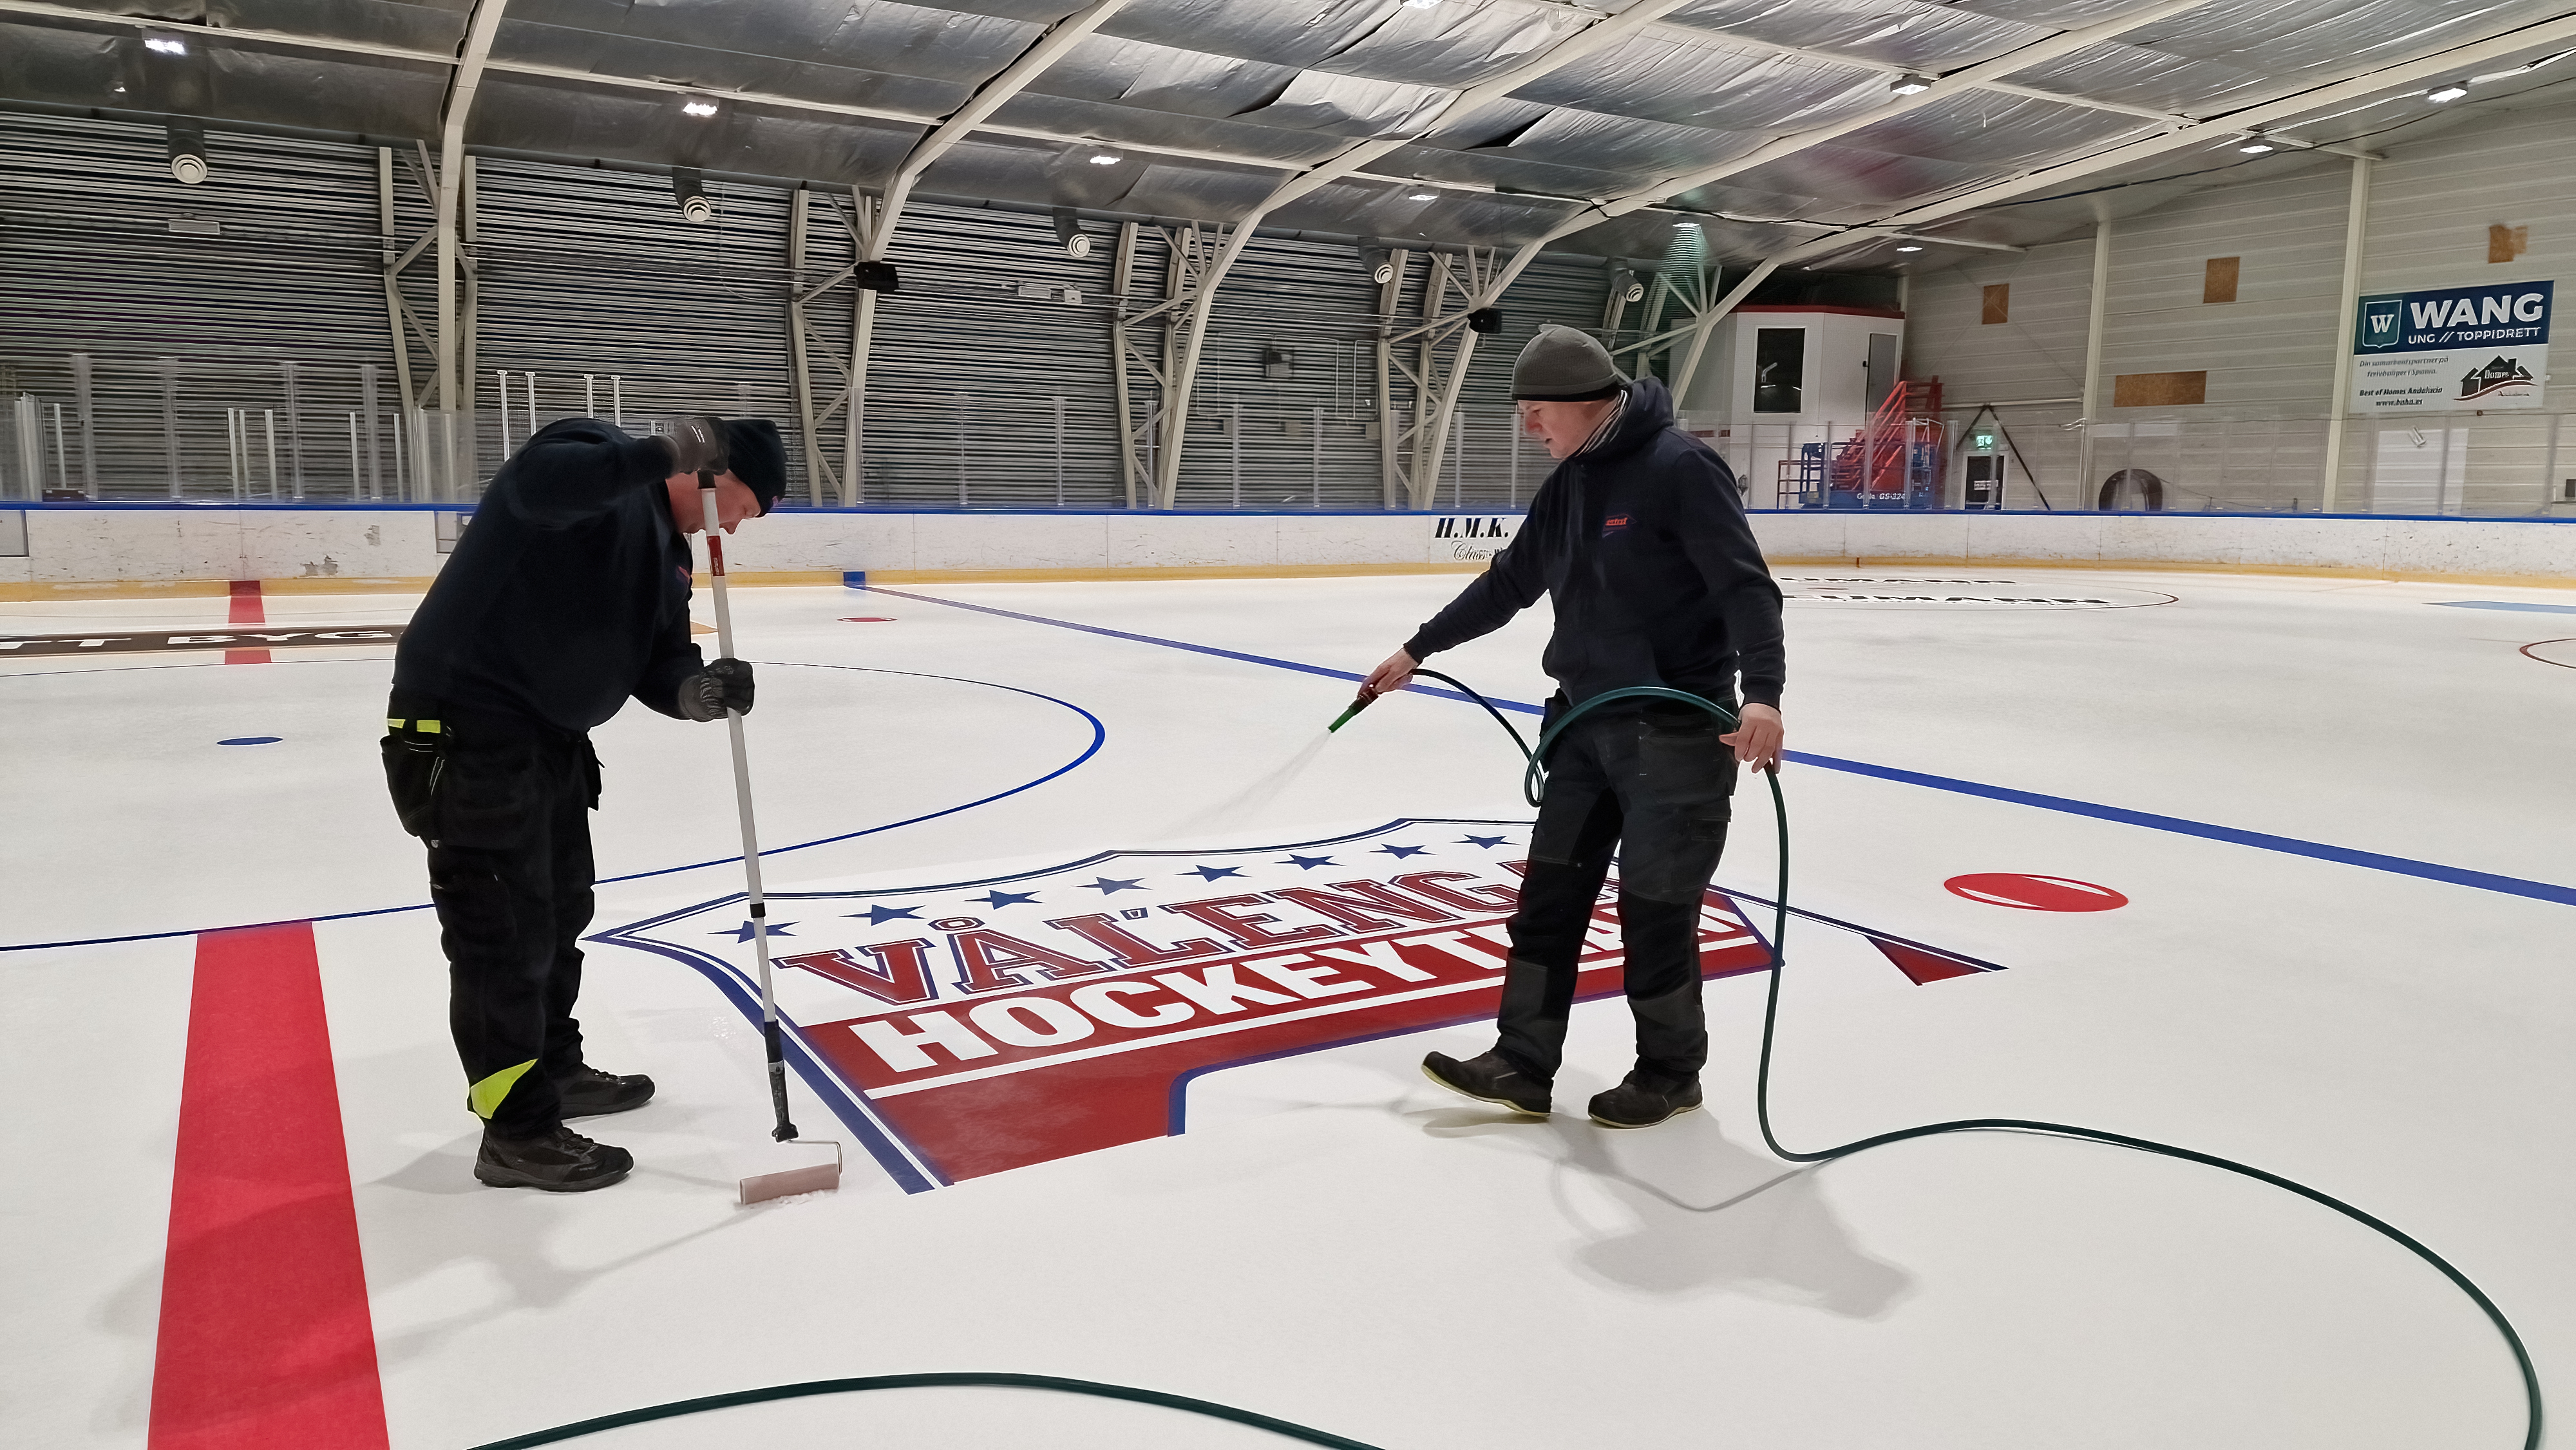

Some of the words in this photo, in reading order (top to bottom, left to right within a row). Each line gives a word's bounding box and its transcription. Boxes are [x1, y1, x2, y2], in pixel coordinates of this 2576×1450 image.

[2410, 293, 2544, 329] WANG
[2370, 314, 2394, 334] W
[2408, 334, 2435, 344] UNG
[2456, 326, 2541, 341] TOPPIDRETT
[167, 630, 394, 645] BYG
